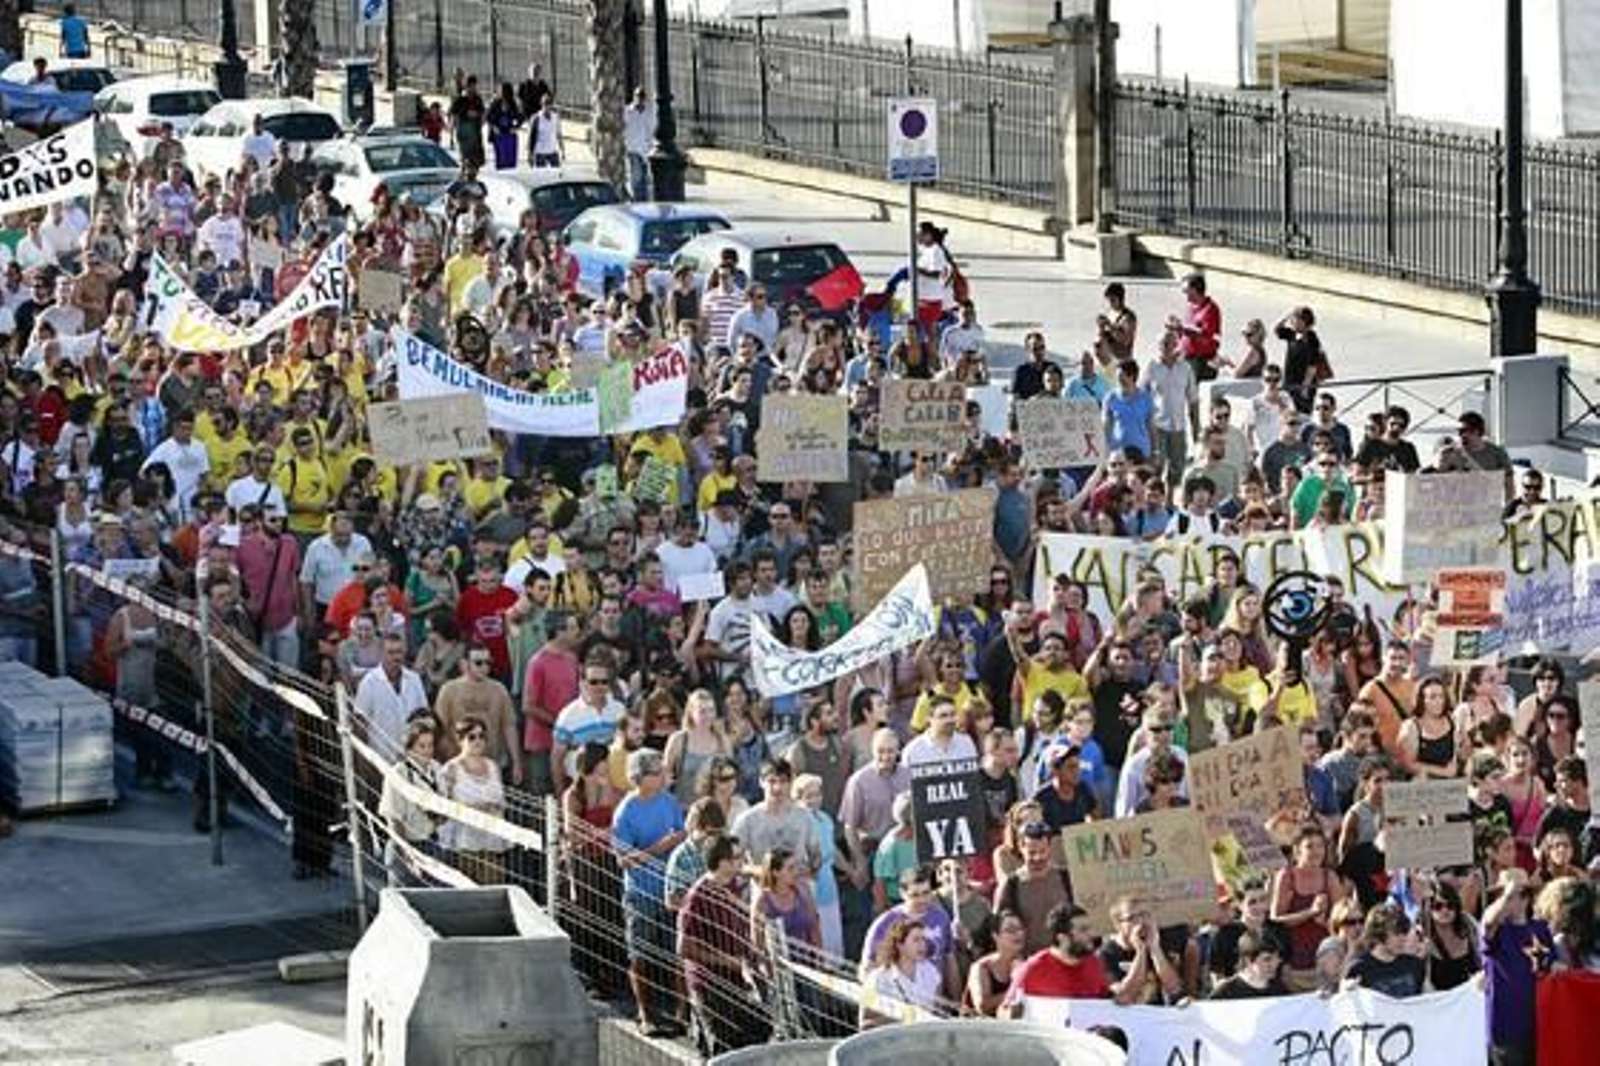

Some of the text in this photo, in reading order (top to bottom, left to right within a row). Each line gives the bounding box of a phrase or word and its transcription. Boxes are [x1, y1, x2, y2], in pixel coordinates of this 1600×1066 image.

[926, 781, 969, 804] REAL
[924, 816, 977, 858] YA
[1275, 1023, 1414, 1066] PACTO
